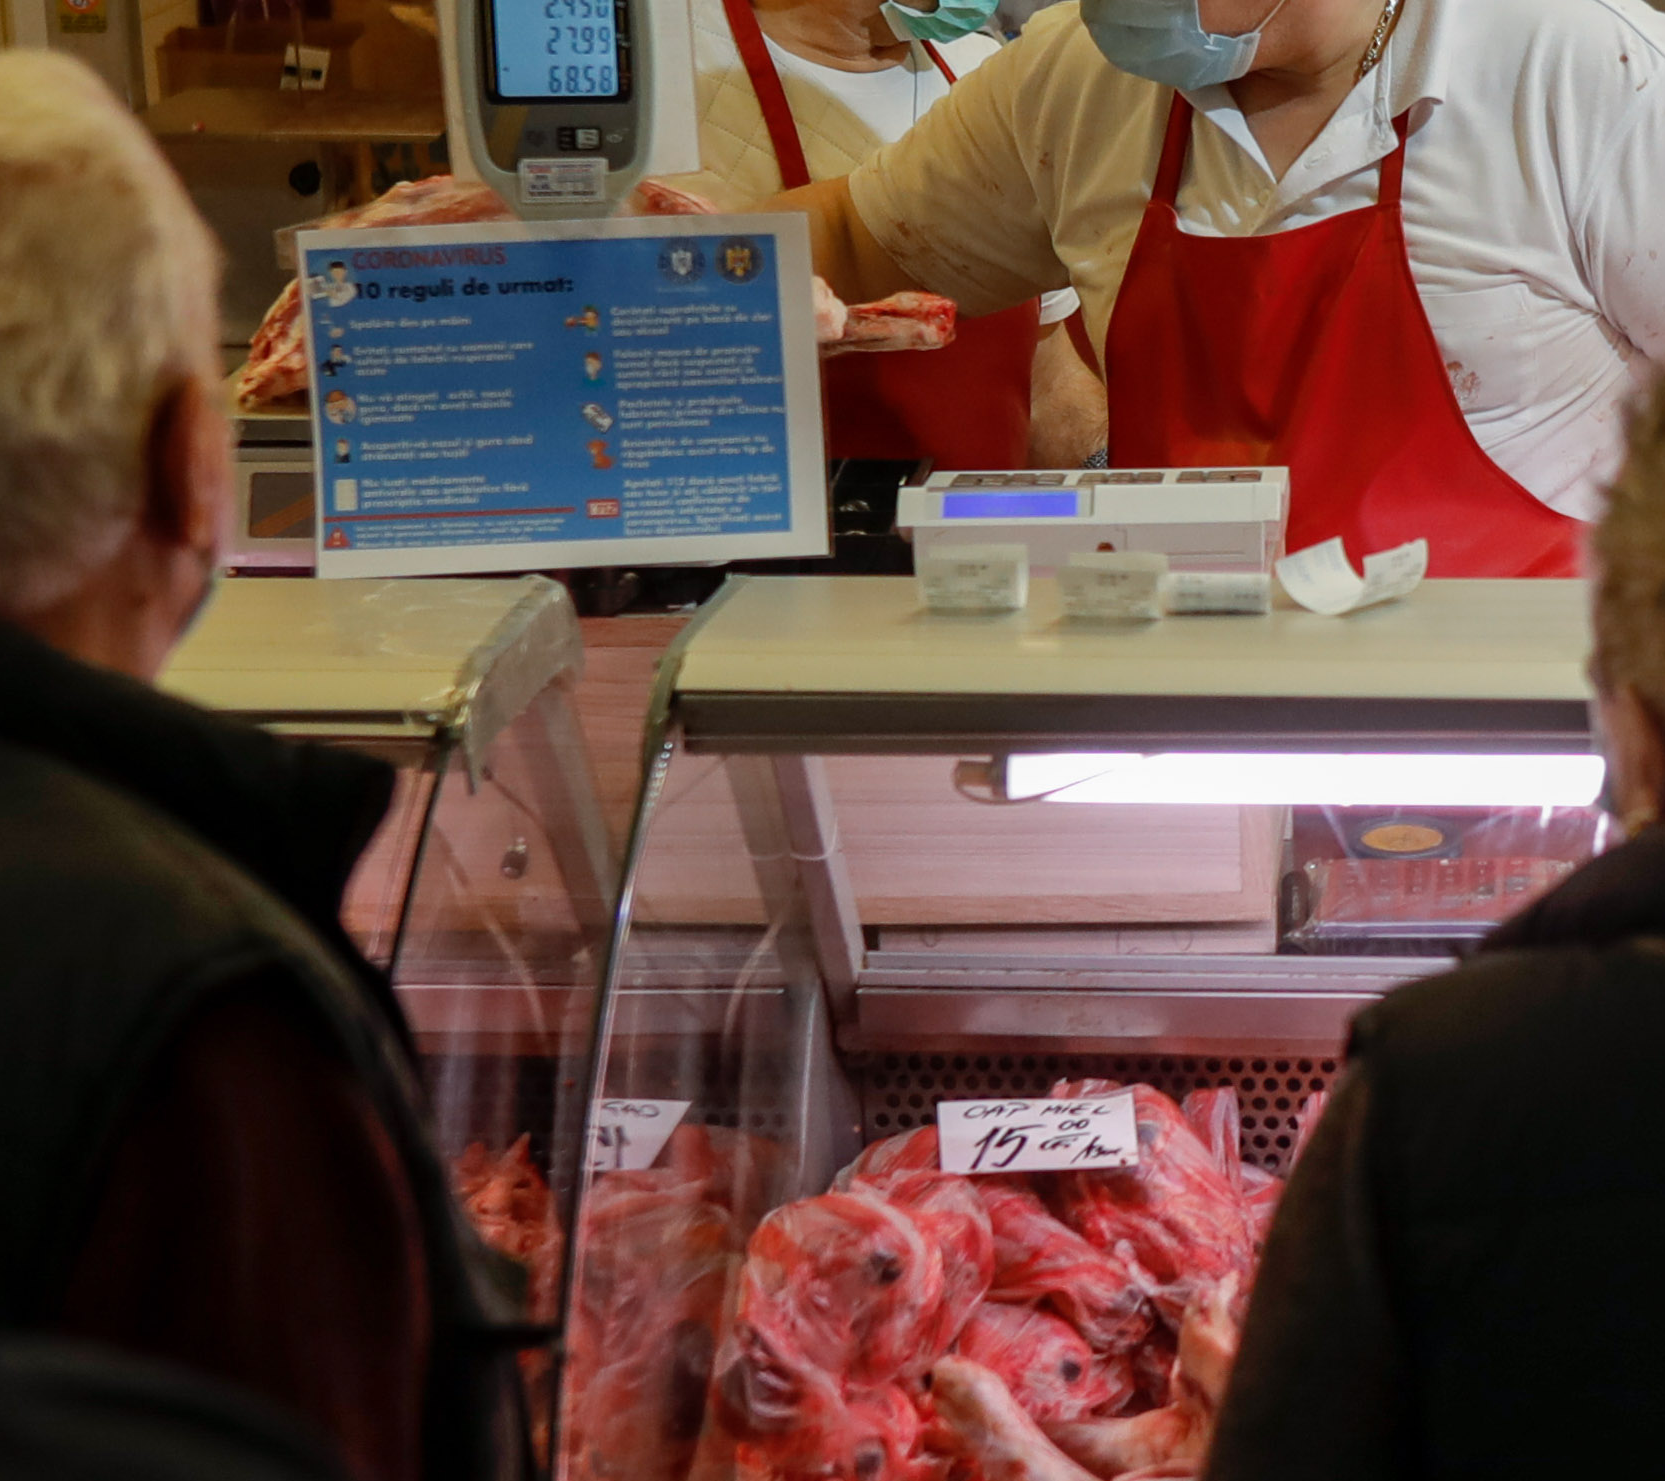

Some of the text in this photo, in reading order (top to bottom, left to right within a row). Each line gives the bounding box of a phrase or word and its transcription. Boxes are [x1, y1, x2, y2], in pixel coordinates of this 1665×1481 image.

[352, 246, 507, 271] CORONAVIRUS
[388, 278, 455, 303] reguli
[462, 277, 491, 296] de
[498, 276, 574, 295] urmat:
[970, 1118, 1091, 1170] 15 00
